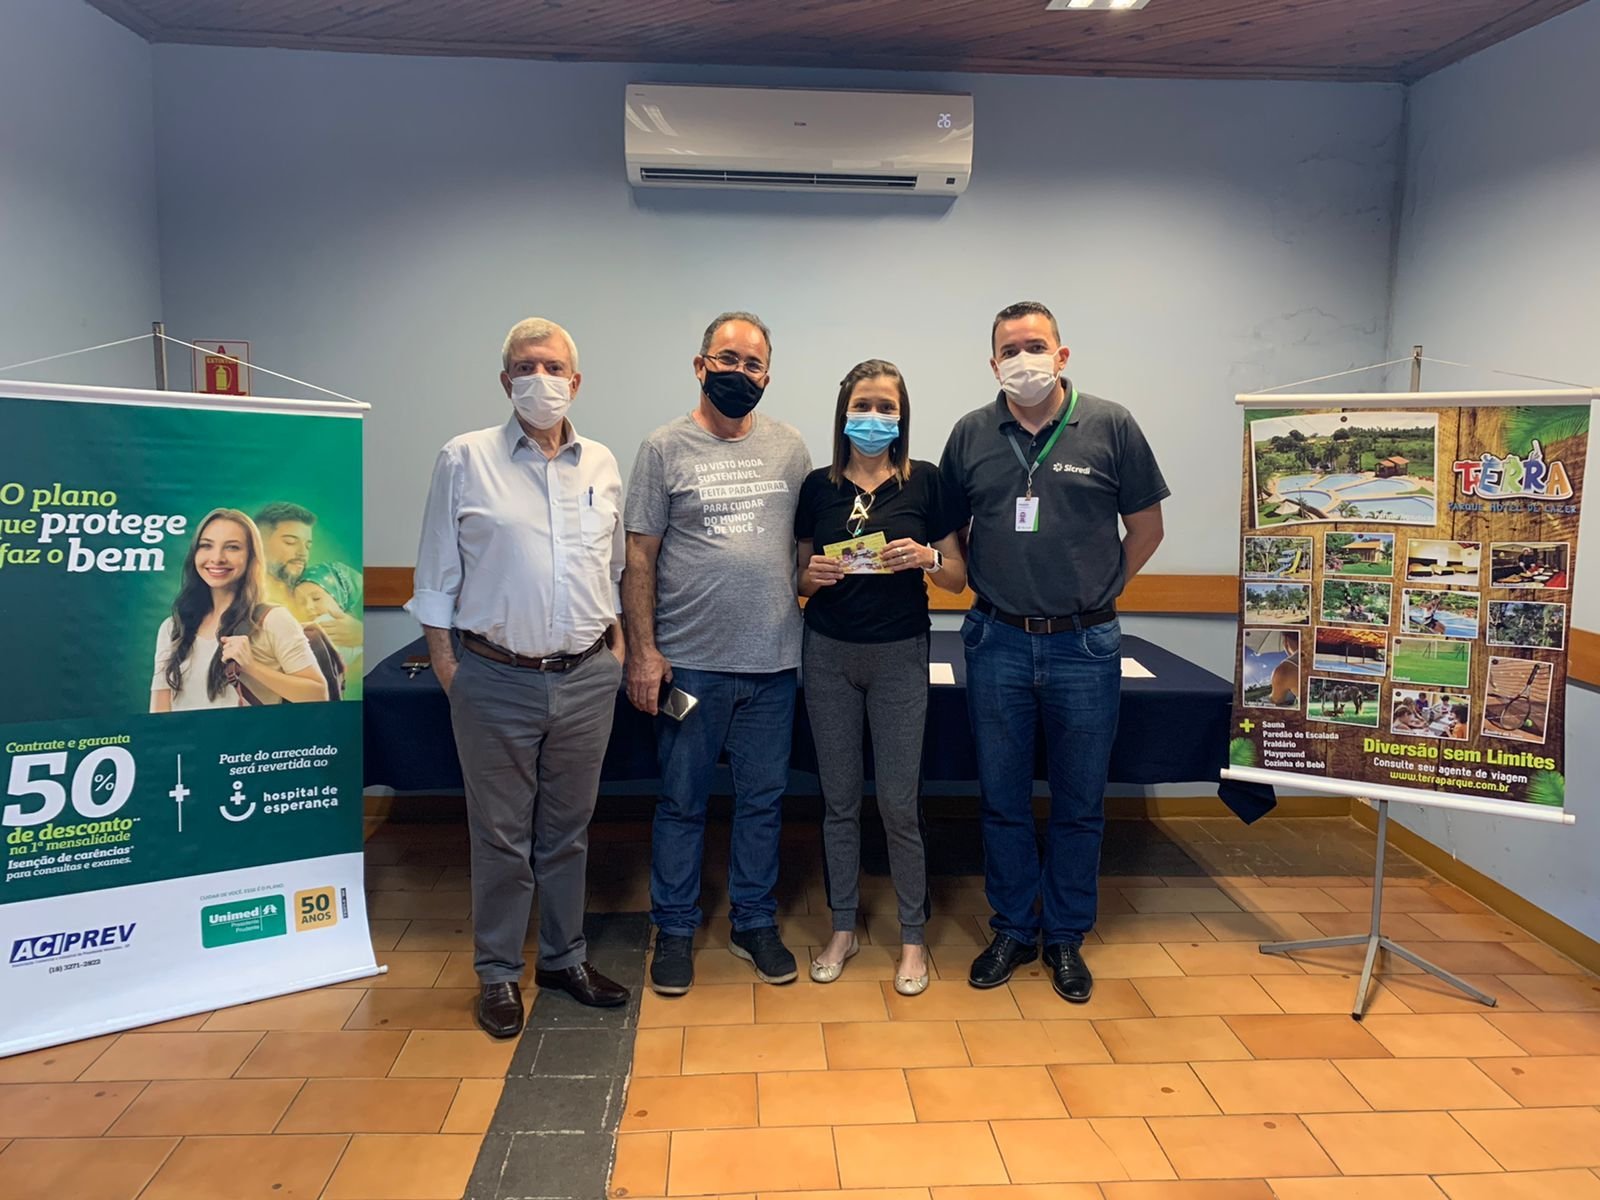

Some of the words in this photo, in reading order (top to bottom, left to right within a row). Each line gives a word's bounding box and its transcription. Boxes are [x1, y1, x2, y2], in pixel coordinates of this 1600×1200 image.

[937, 113, 951, 128] 26
[695, 463, 708, 473] EU
[710, 461, 735, 470] VISTO
[738, 459, 764, 468] MODA
[1454, 440, 1573, 498] TERRA
[1, 483, 25, 505] O
[30, 483, 117, 512] plano
[701, 487, 727, 498] FEITA
[729, 485, 753, 495] PARA
[703, 503, 728, 513] PARA
[730, 499, 765, 511] CUIDAR
[38, 509, 188, 544] protege
[704, 516, 718, 527] DO
[720, 512, 755, 524] MUNDO
[714, 524, 728, 535] DE
[728, 522, 754, 534] VOCÊ
[0, 543, 40, 569] faz
[47, 548, 63, 564] o
[67, 538, 165, 572] bem
[1262, 721, 1285, 729] Sauna
[5, 739, 65, 753] Contrate
[67, 739, 76, 748] e
[78, 734, 131, 750] garanta
[1262, 730, 1292, 739] Paredão
[1294, 731, 1304, 739] de
[1305, 731, 1339, 740] Escalada
[1263, 740, 1296, 748] Fraldário
[218, 752, 252, 765] Parte
[254, 750, 270, 761] do
[271, 745, 338, 759] arrecadado
[1263, 750, 1305, 759] Playground
[1363, 738, 1438, 759] Diversão
[1443, 748, 1481, 763] sem
[1487, 749, 1556, 771] Limites
[229, 764, 256, 775] será
[257, 758, 312, 773] revertida
[314, 758, 329, 768] ao
[1264, 759, 1293, 768] Cozinha
[1295, 760, 1305, 768] do
[1306, 761, 1325, 769] Bebê
[1373, 757, 1414, 771] Consulte
[1418, 764, 1435, 773] seu
[1439, 766, 1471, 778] agente
[1475, 769, 1488, 779] de
[1491, 771, 1528, 784] viagem
[2, 746, 136, 826] 50
[1389, 770, 1510, 793] www.terraparque.com.br
[263, 787, 319, 802] hospital
[321, 785, 339, 796] de
[263, 797, 339, 814] esperança
[6, 826, 35, 844] de
[9, 845, 27, 855] na
[45, 832, 131, 851] mensalidade
[5, 871, 32, 882] para
[33, 863, 82, 876] consultas
[91, 856, 132, 868] exames.
[7, 857, 56, 870] Isenção
[57, 853, 72, 862] de
[301, 893, 330, 915] 50
[209, 906, 260, 924] Unimed
[301, 911, 331, 925] ANOS
[9, 922, 137, 963] ACIPREV
